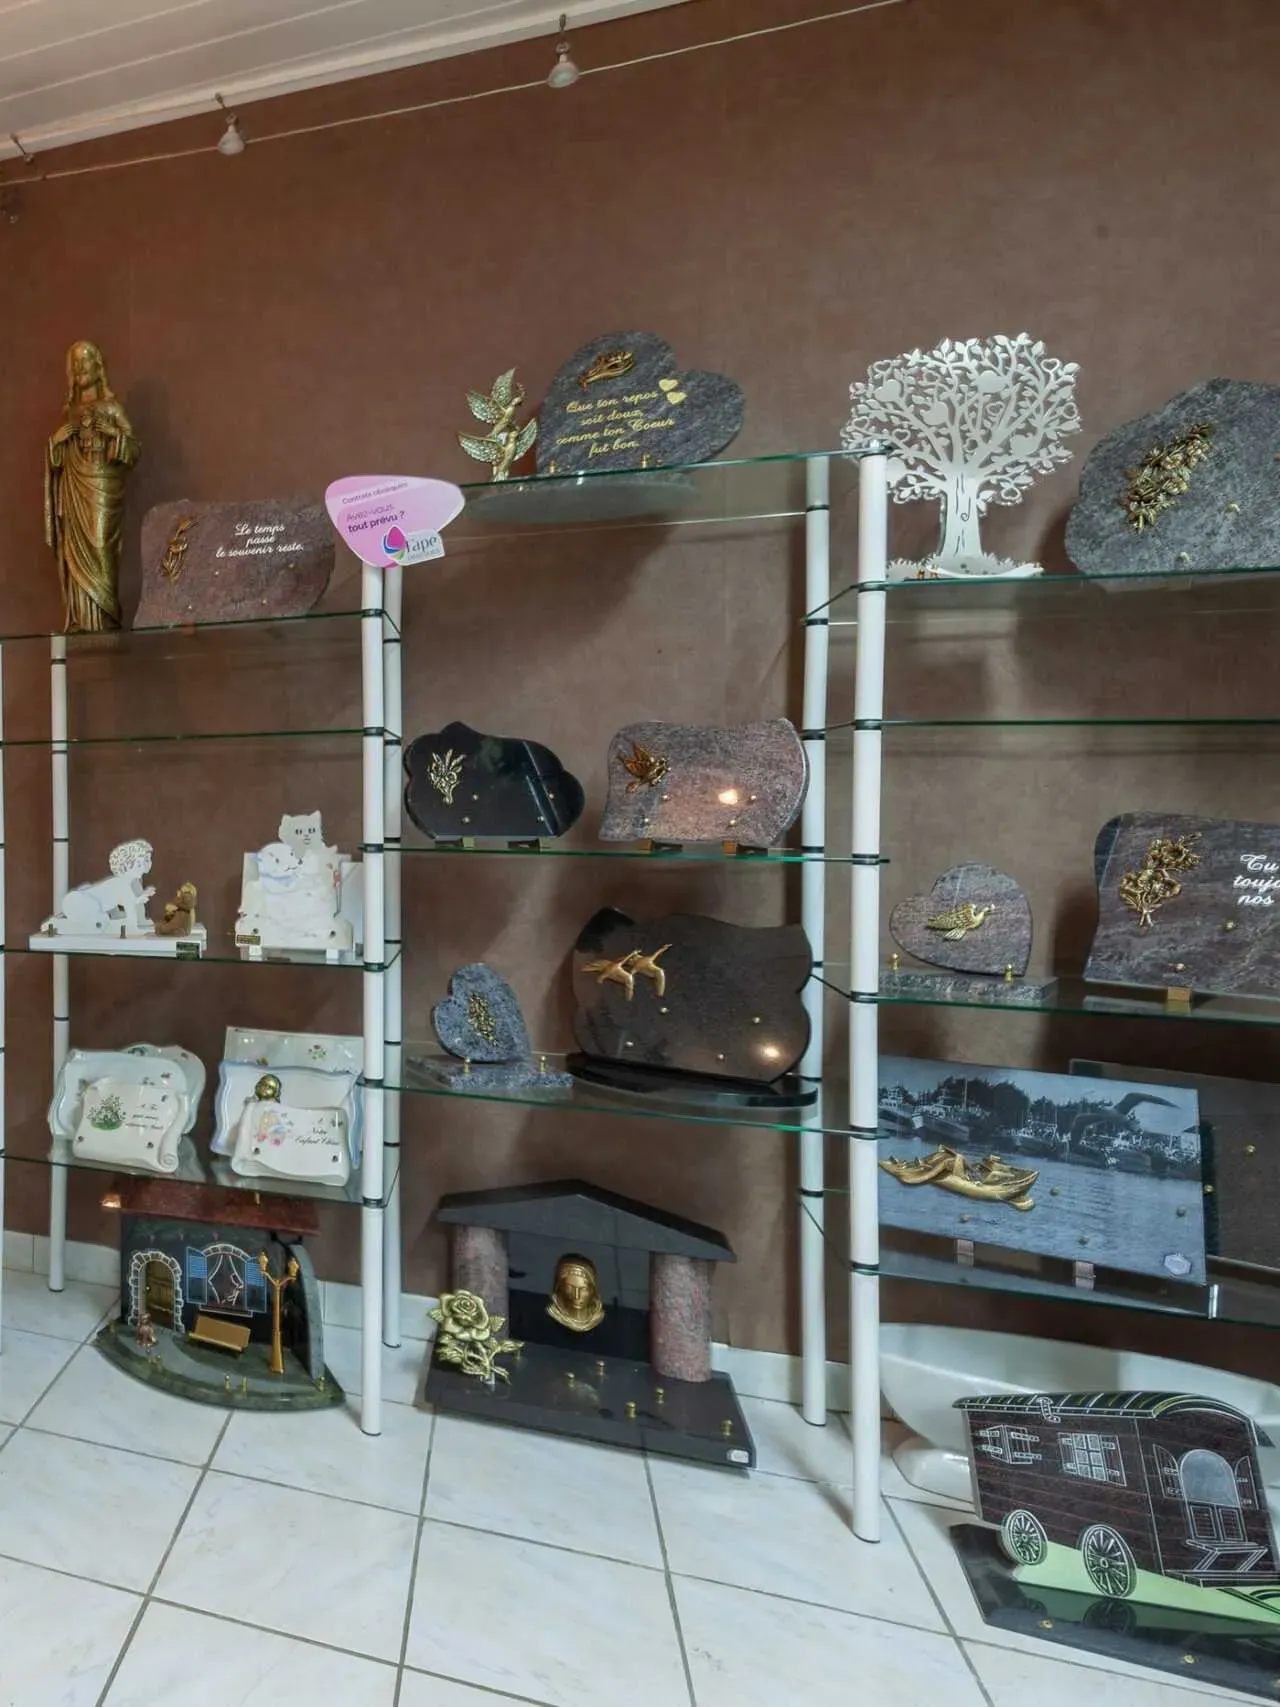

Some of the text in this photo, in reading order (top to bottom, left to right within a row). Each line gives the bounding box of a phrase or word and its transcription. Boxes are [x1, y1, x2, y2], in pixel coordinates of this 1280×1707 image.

[622, 391, 658, 405] repos
[580, 414, 604, 426] soit
[556, 430, 600, 446] comme
[628, 417, 675, 433] Coeur
[234, 523, 285, 536] Le temps
[348, 521, 369, 532] tout
[215, 546, 226, 558] le
[228, 545, 274, 556] souvenir
[1240, 854, 1279, 872] Tu
[1237, 895, 1274, 906] nos
